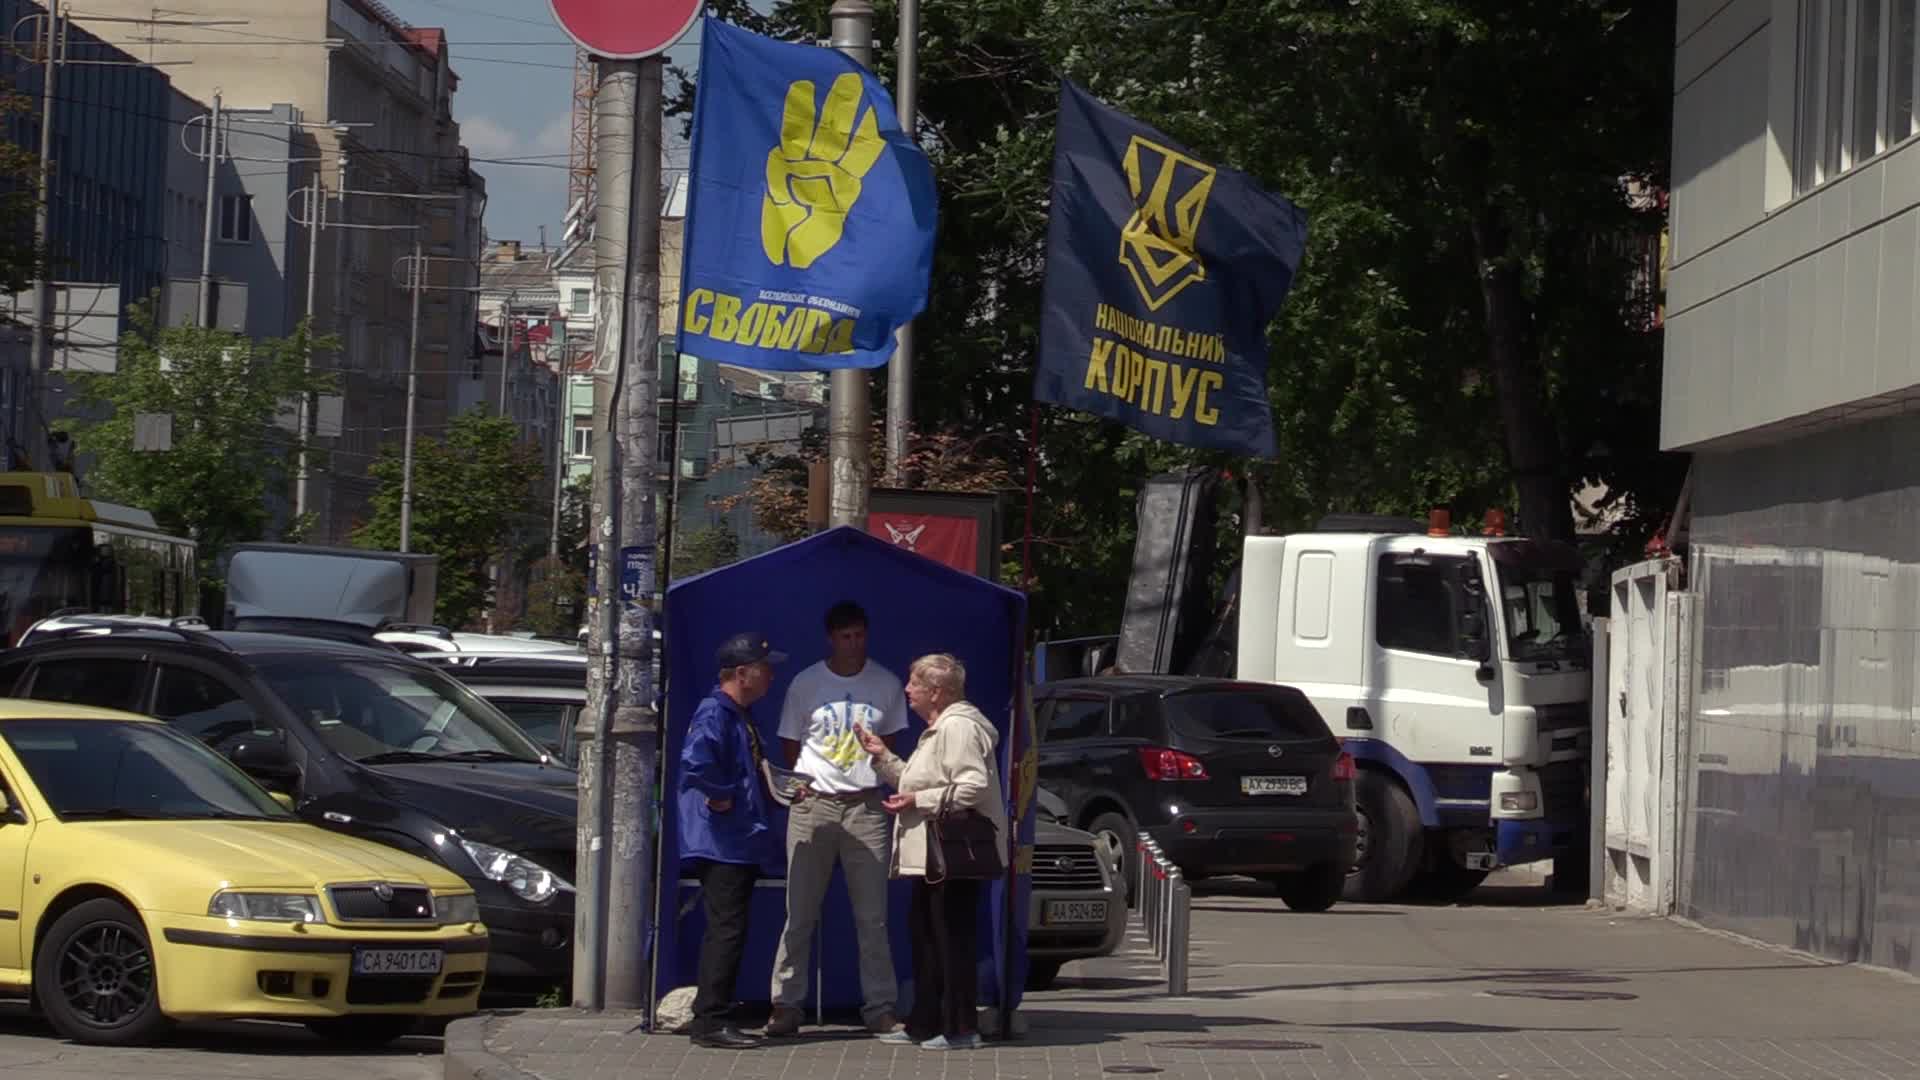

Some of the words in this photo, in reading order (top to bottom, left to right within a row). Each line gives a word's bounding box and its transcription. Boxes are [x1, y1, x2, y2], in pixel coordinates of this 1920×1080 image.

[684, 287, 856, 354] СВОБОДА
[1095, 302, 1225, 364] НАЦІОНАЛЬНИЙ
[1084, 336, 1224, 426] КОРПУС
[385, 951, 416, 970] 9401
